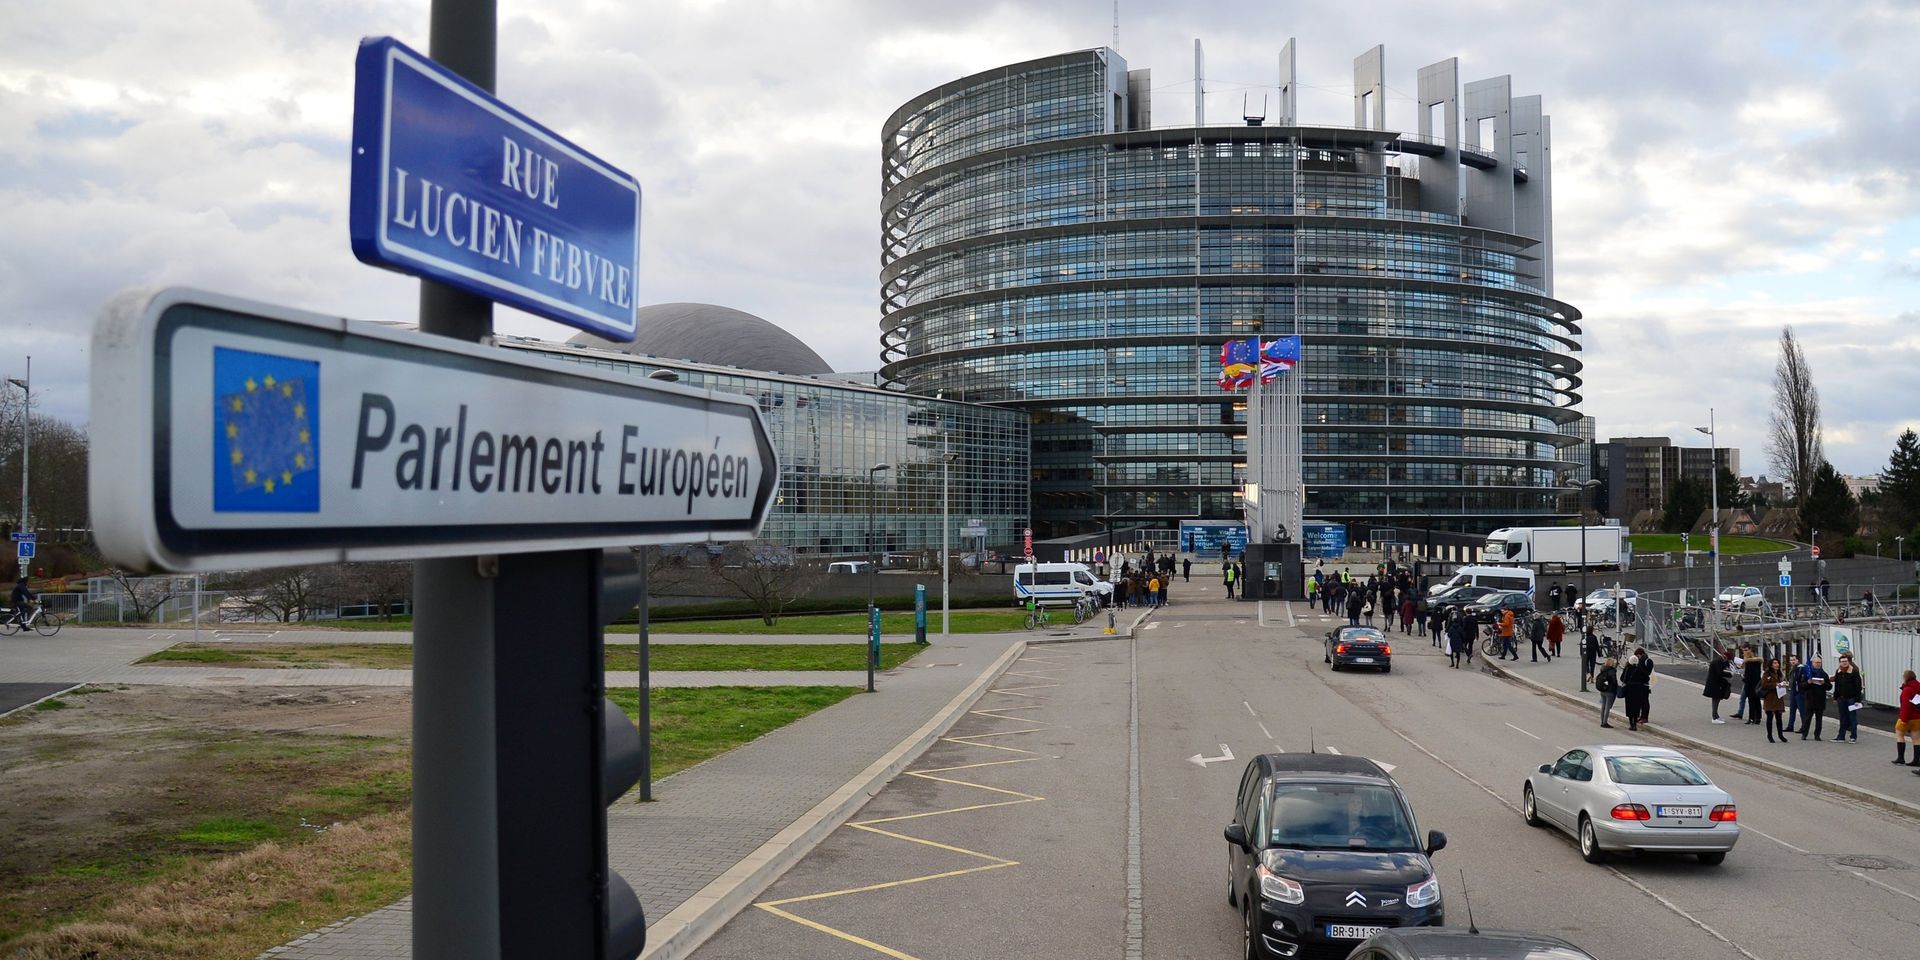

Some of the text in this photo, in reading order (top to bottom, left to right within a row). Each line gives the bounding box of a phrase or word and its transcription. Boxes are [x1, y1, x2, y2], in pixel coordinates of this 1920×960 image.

[501, 136, 559, 210] RUE
[393, 166, 631, 309] LUCIEN FEBVRE
[350, 391, 749, 515] Parlement Européen
